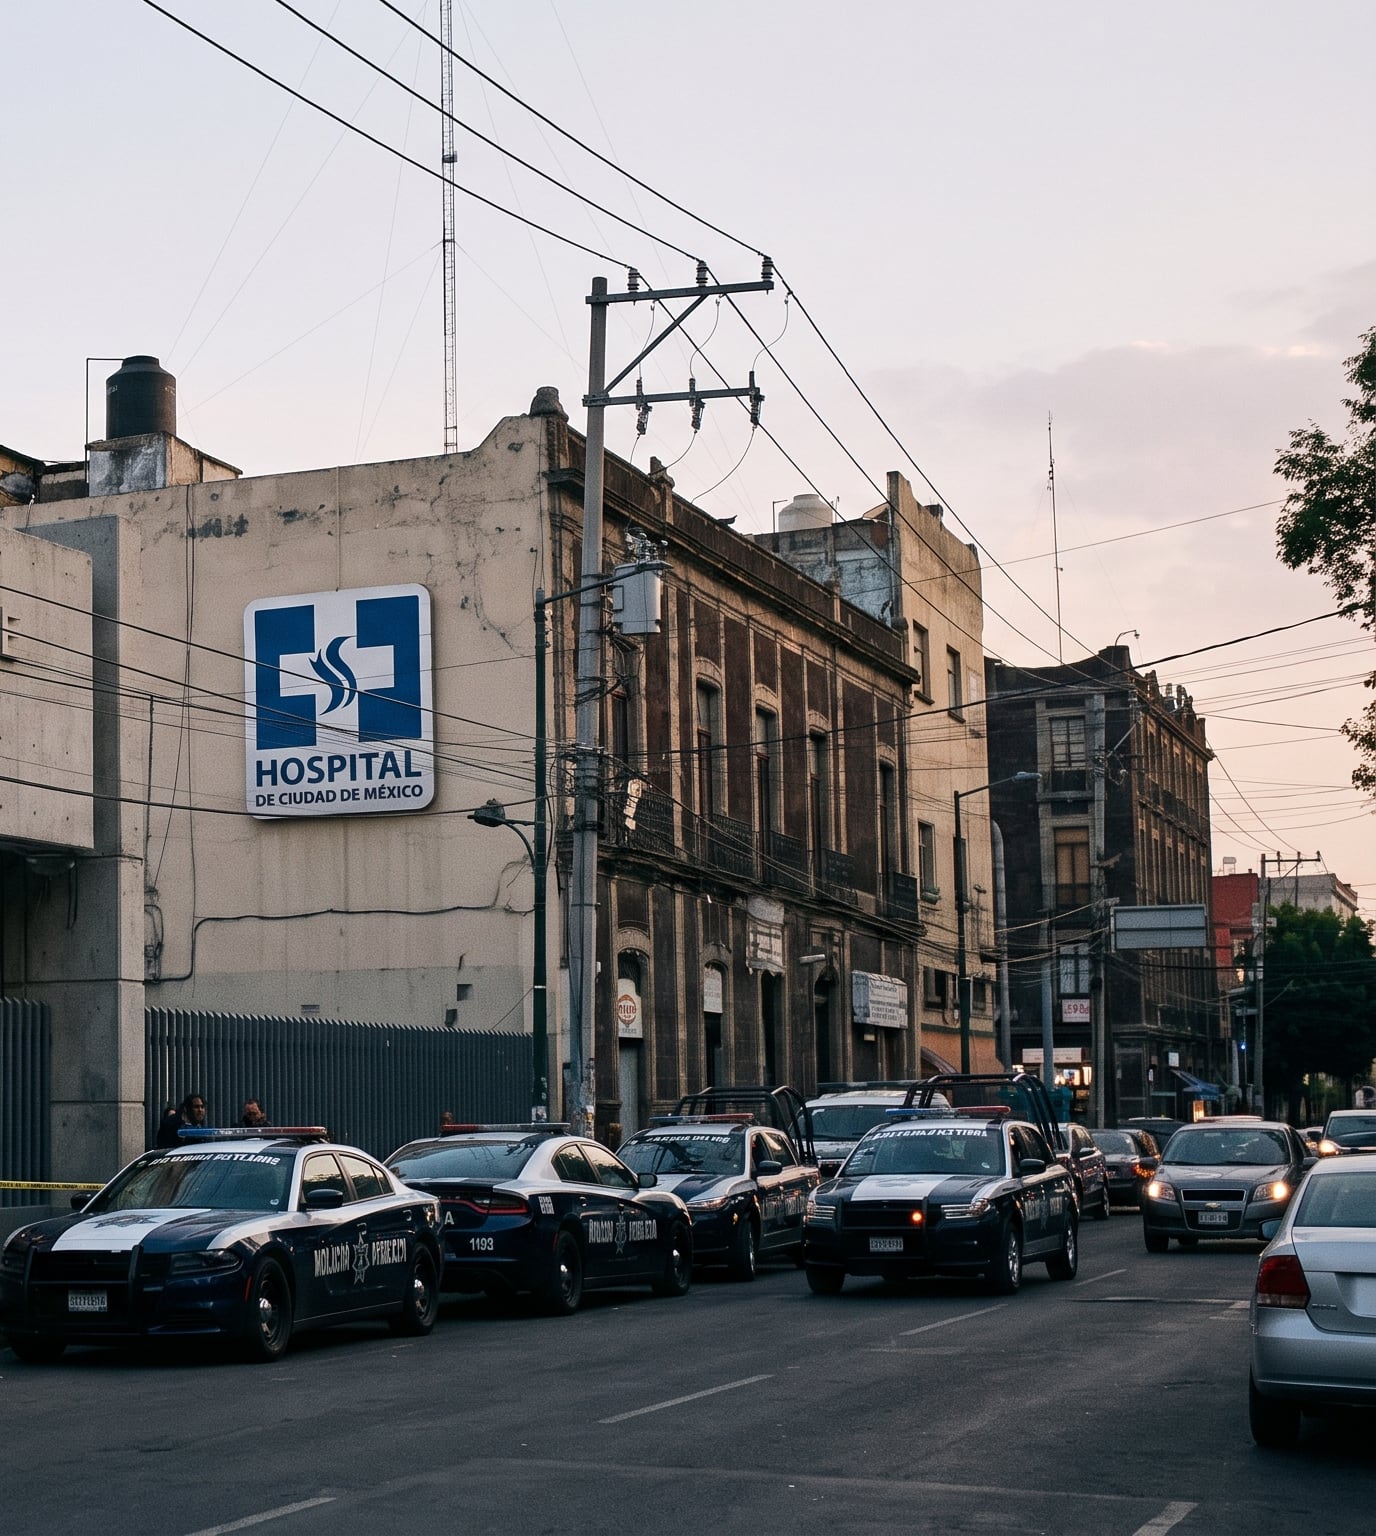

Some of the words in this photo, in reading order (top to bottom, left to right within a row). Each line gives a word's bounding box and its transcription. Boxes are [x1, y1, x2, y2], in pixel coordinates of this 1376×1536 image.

[256, 750, 422, 787] HOSPITAL
[255, 794, 276, 807] DE
[278, 790, 337, 805] CIUDAD
[340, 788, 361, 802] DE
[364, 784, 423, 801] MÉXICO
[469, 1237, 494, 1251] 1193
